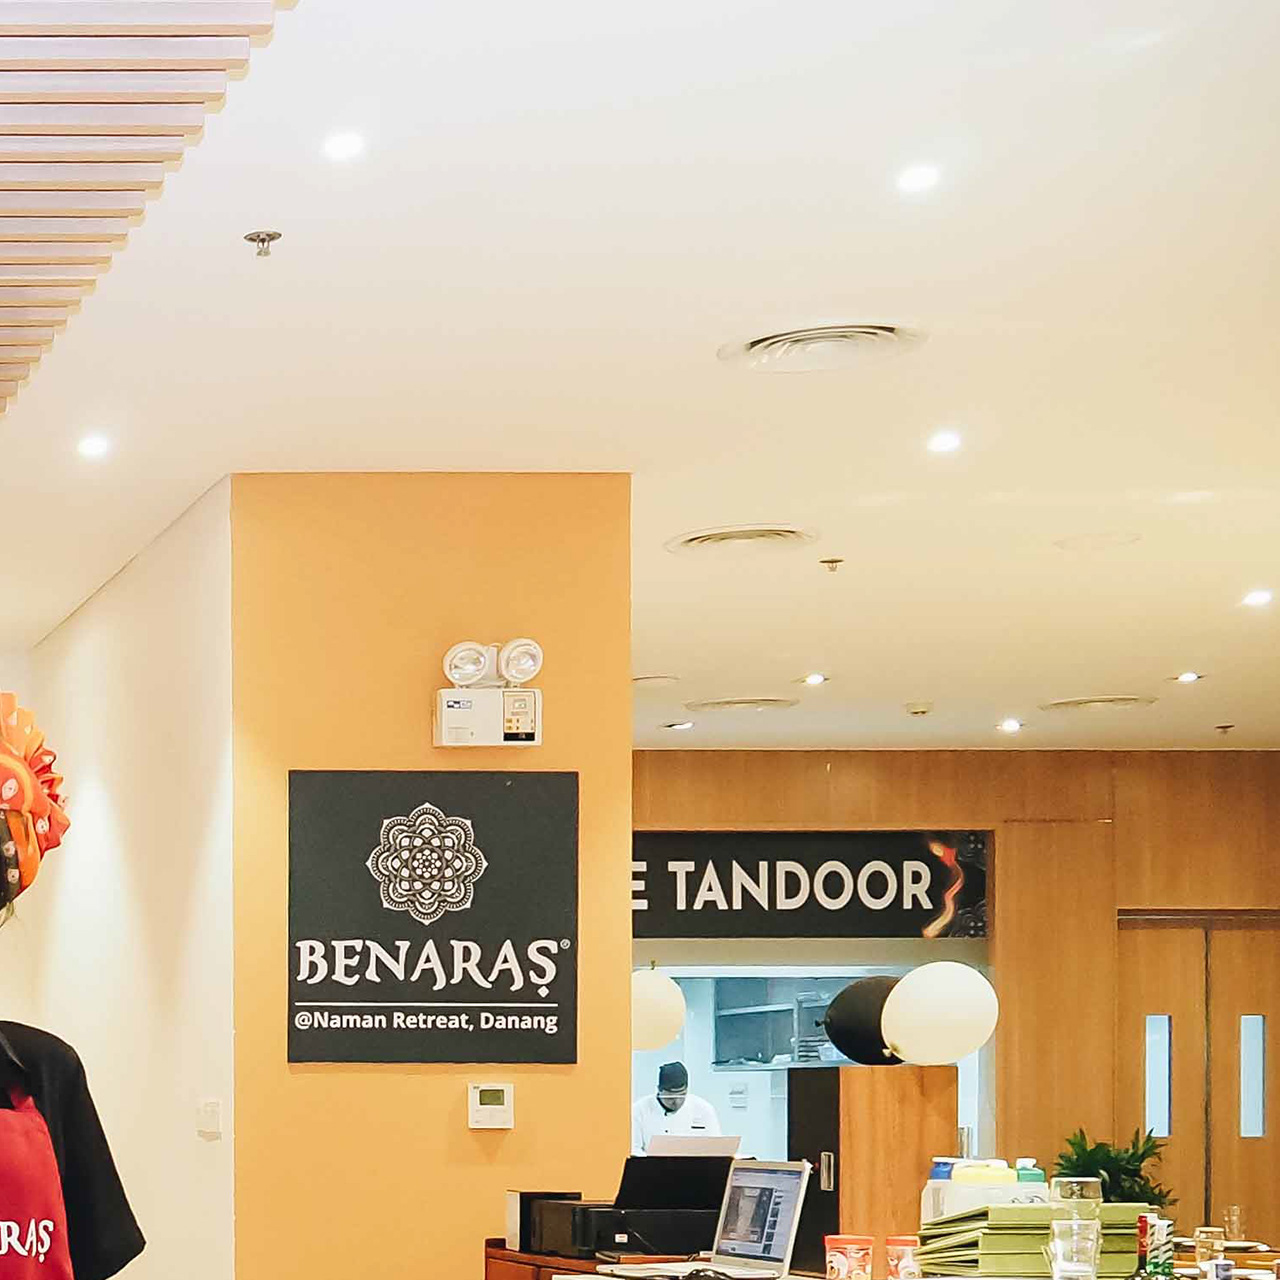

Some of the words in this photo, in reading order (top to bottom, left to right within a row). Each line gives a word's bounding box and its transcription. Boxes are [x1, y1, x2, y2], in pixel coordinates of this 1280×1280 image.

[667, 859, 934, 911] TANDOOR
[294, 1011, 387, 1030] @Naman
[393, 1012, 475, 1032] Retreat,
[480, 1012, 559, 1034] Danang
